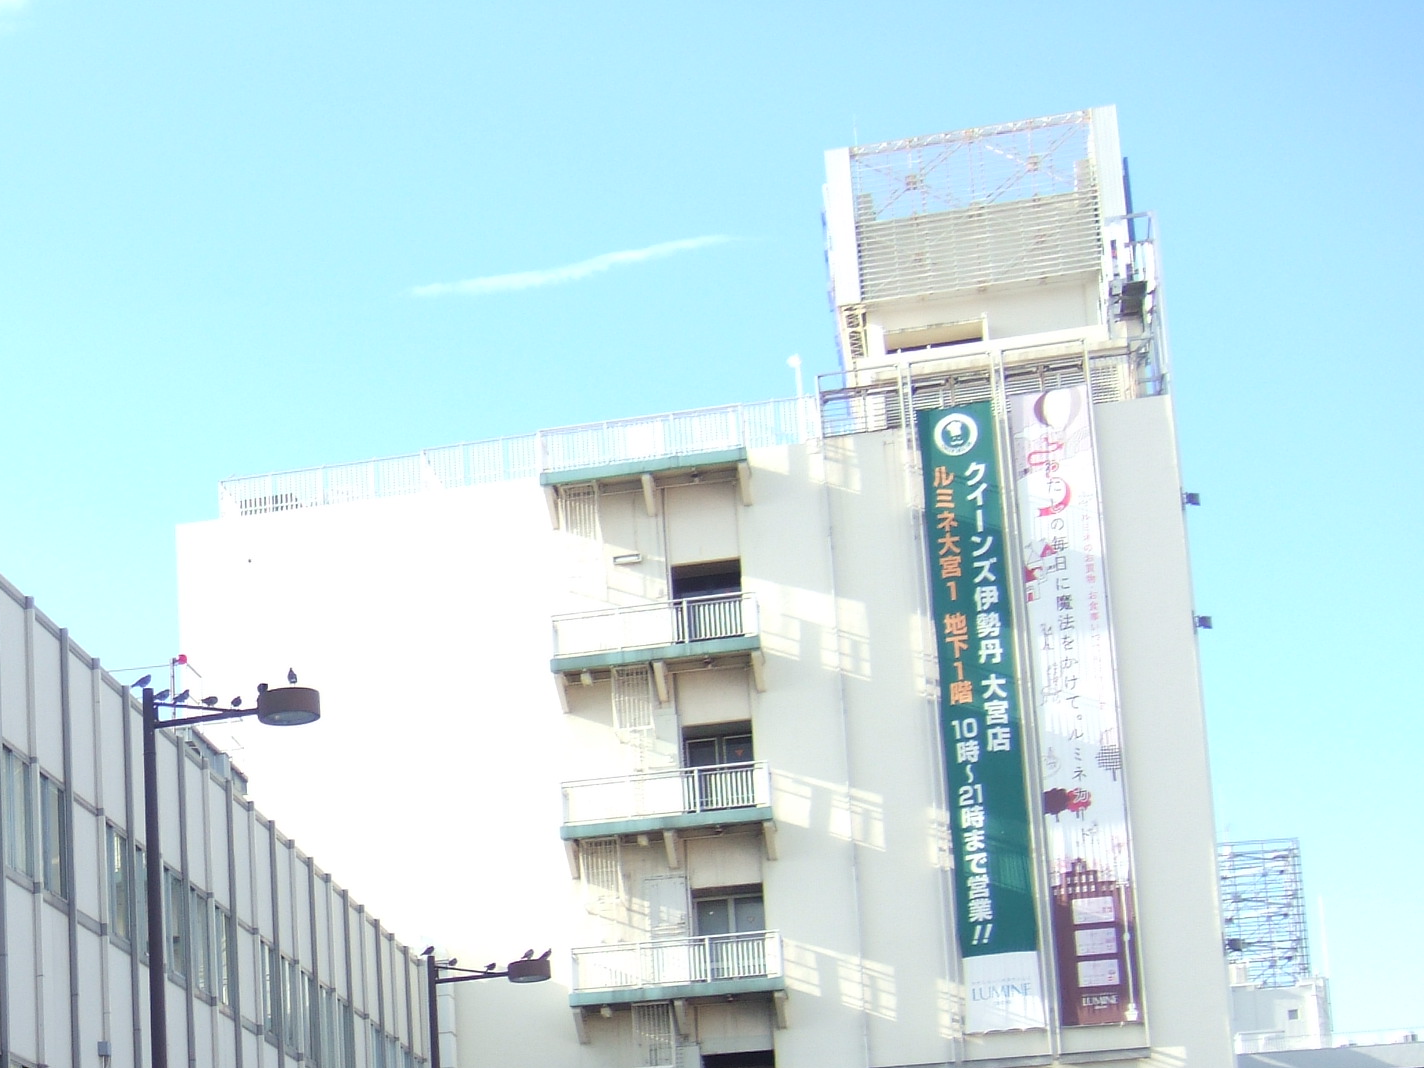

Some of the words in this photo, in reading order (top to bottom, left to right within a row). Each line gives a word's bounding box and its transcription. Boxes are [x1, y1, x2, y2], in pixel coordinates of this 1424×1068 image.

[933, 465, 963, 601] ルミネ大宮1
[964, 461, 1003, 664] クイーンズ伊勢丹
[944, 612, 973, 706] 地下1階
[982, 673, 1010, 752] 大宮店
[972, 982, 1032, 1001] LUMINE
